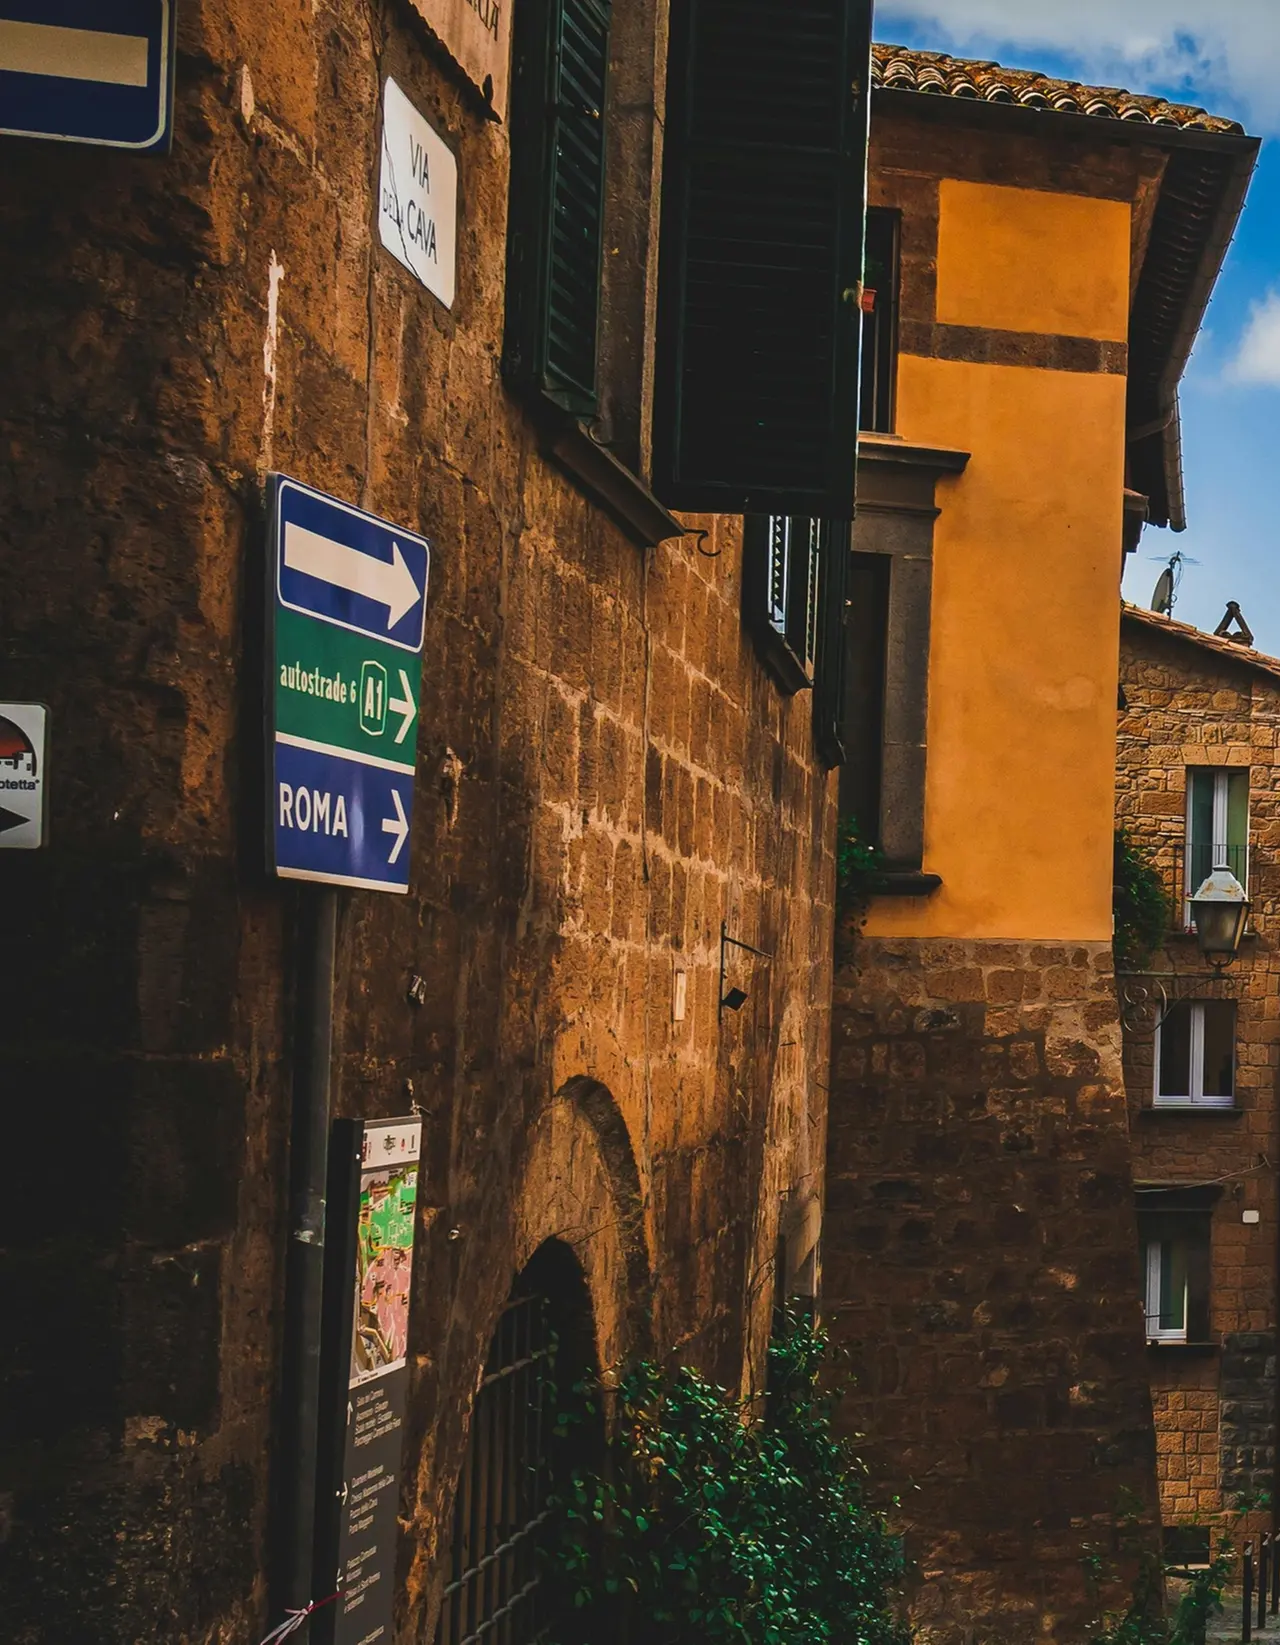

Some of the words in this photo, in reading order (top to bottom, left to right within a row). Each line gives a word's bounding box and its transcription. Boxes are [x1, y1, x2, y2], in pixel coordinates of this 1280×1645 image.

[410, 134, 430, 195] VIA
[407, 199, 438, 264] CAVA
[280, 661, 346, 704] autostrade
[364, 677, 383, 720] A1
[280, 781, 348, 838] ROMA
